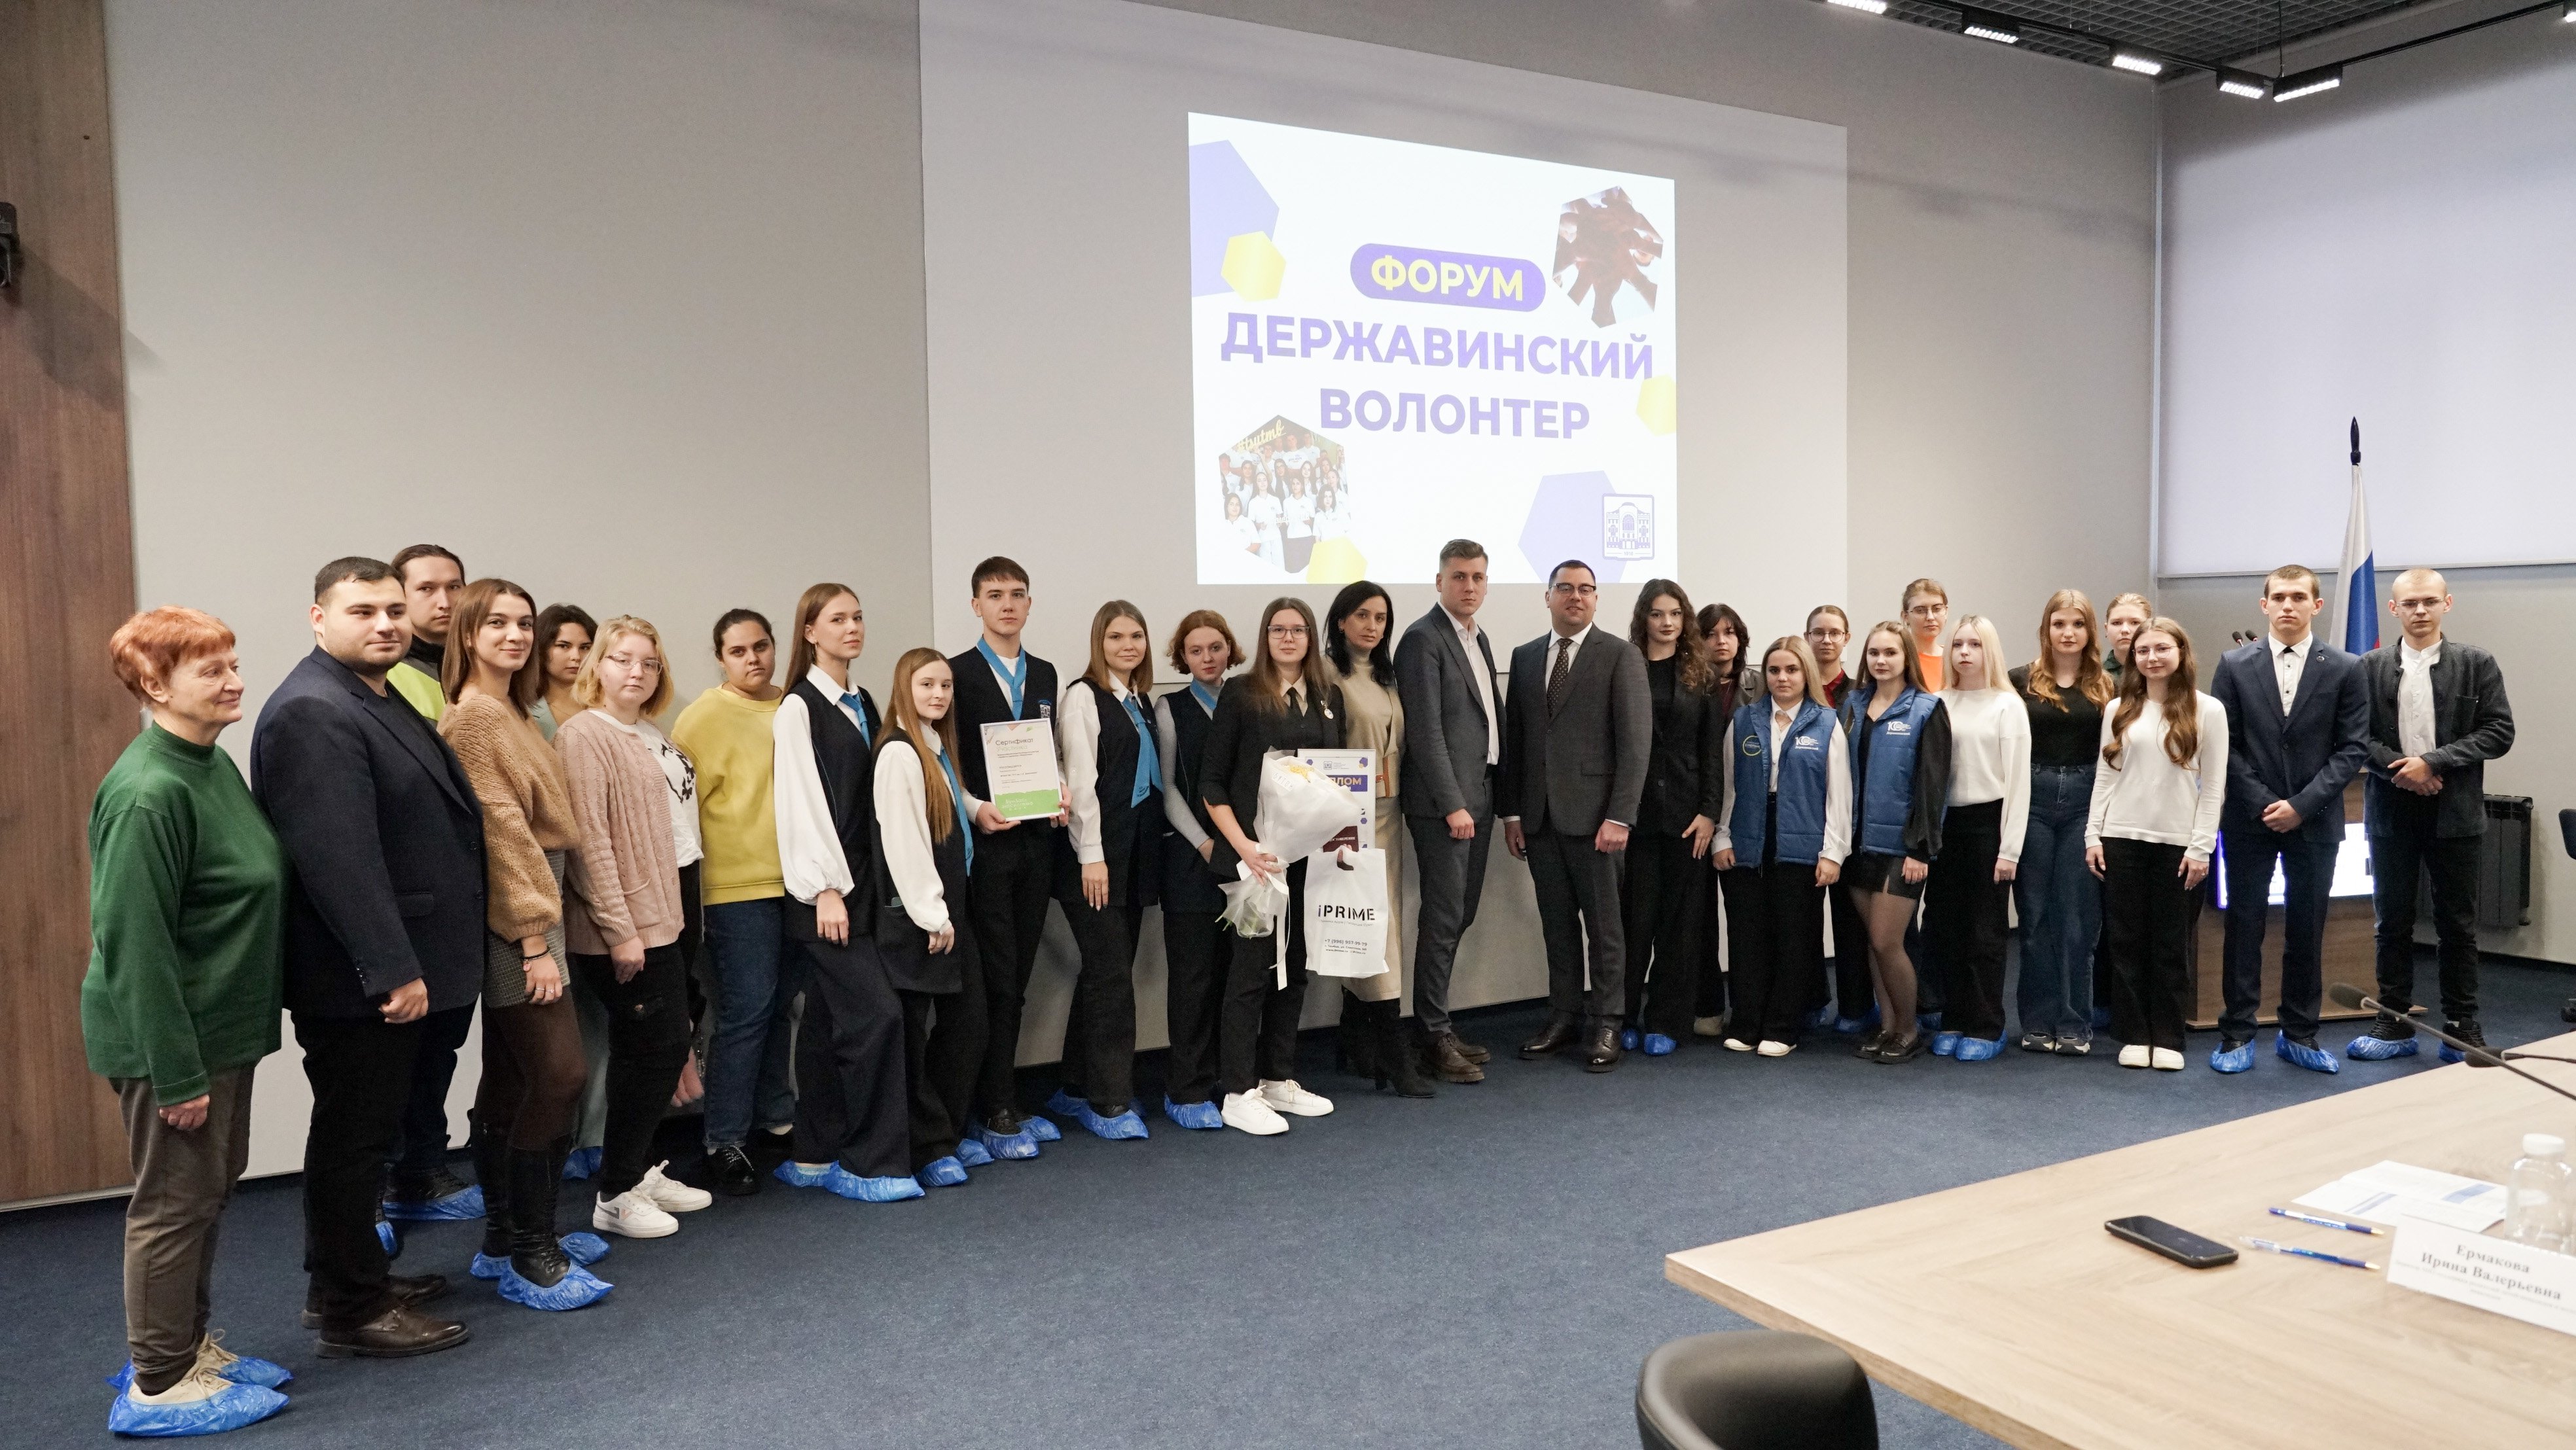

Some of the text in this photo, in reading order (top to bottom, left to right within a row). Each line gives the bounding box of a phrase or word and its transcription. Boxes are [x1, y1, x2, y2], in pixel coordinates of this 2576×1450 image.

[1370, 255, 1523, 301] ФОРУМ
[1221, 312, 1653, 380] ДЕРЖАВИНСКИЙ
[1320, 387, 1590, 439] ВОЛОНТЕР
[1329, 777, 1361, 785] ПЛОМ
[1318, 905, 1375, 921] iPRIME
[2421, 1252, 2467, 1274] Ирина
[2471, 1265, 2562, 1300] Валерьевна
[2456, 1244, 2530, 1273] Ермакова
